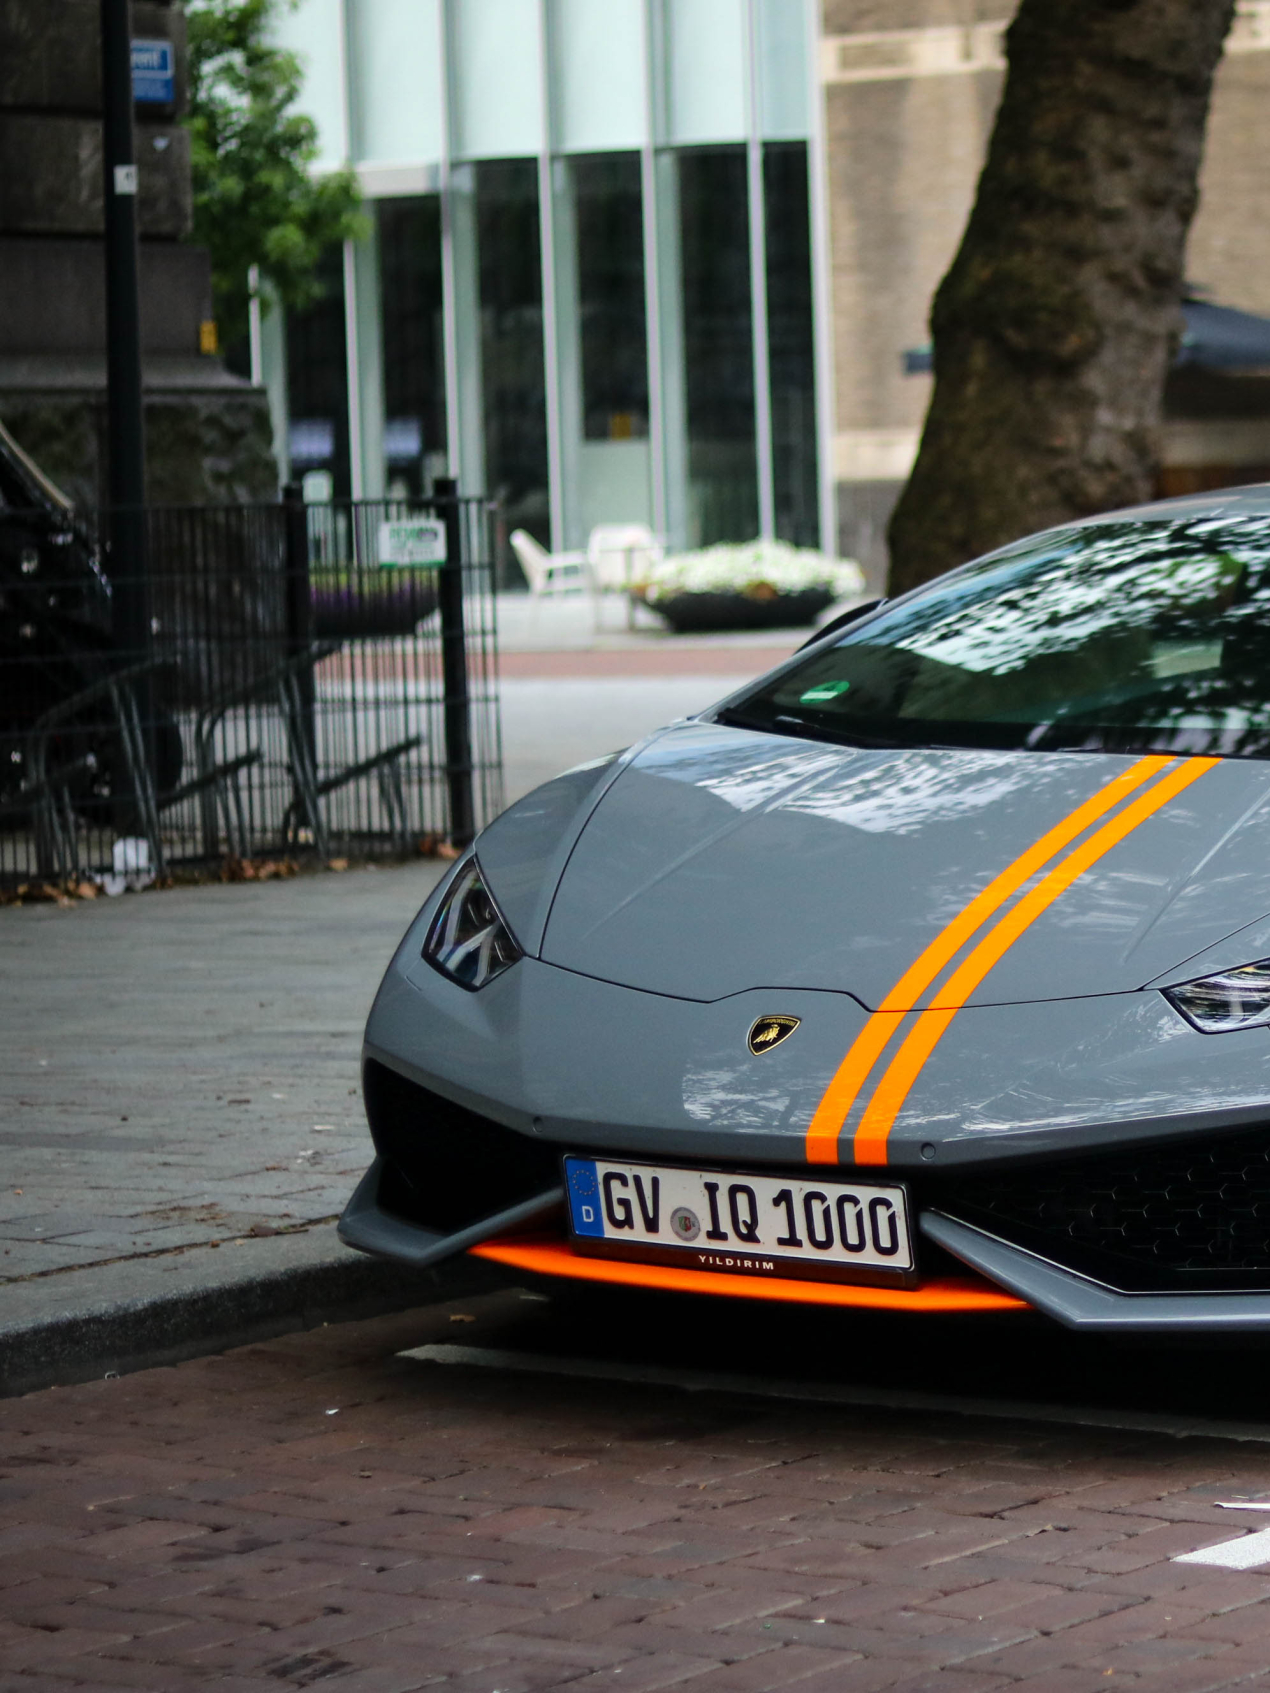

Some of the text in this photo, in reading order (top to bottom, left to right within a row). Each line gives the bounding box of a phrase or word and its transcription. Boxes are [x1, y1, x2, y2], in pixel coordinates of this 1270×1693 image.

[582, 1205, 594, 1222] D
[602, 1171, 660, 1233] GV
[704, 1181, 761, 1244] IQ
[772, 1189, 899, 1256] 1000
[698, 1254, 775, 1270] YILDIRIM
